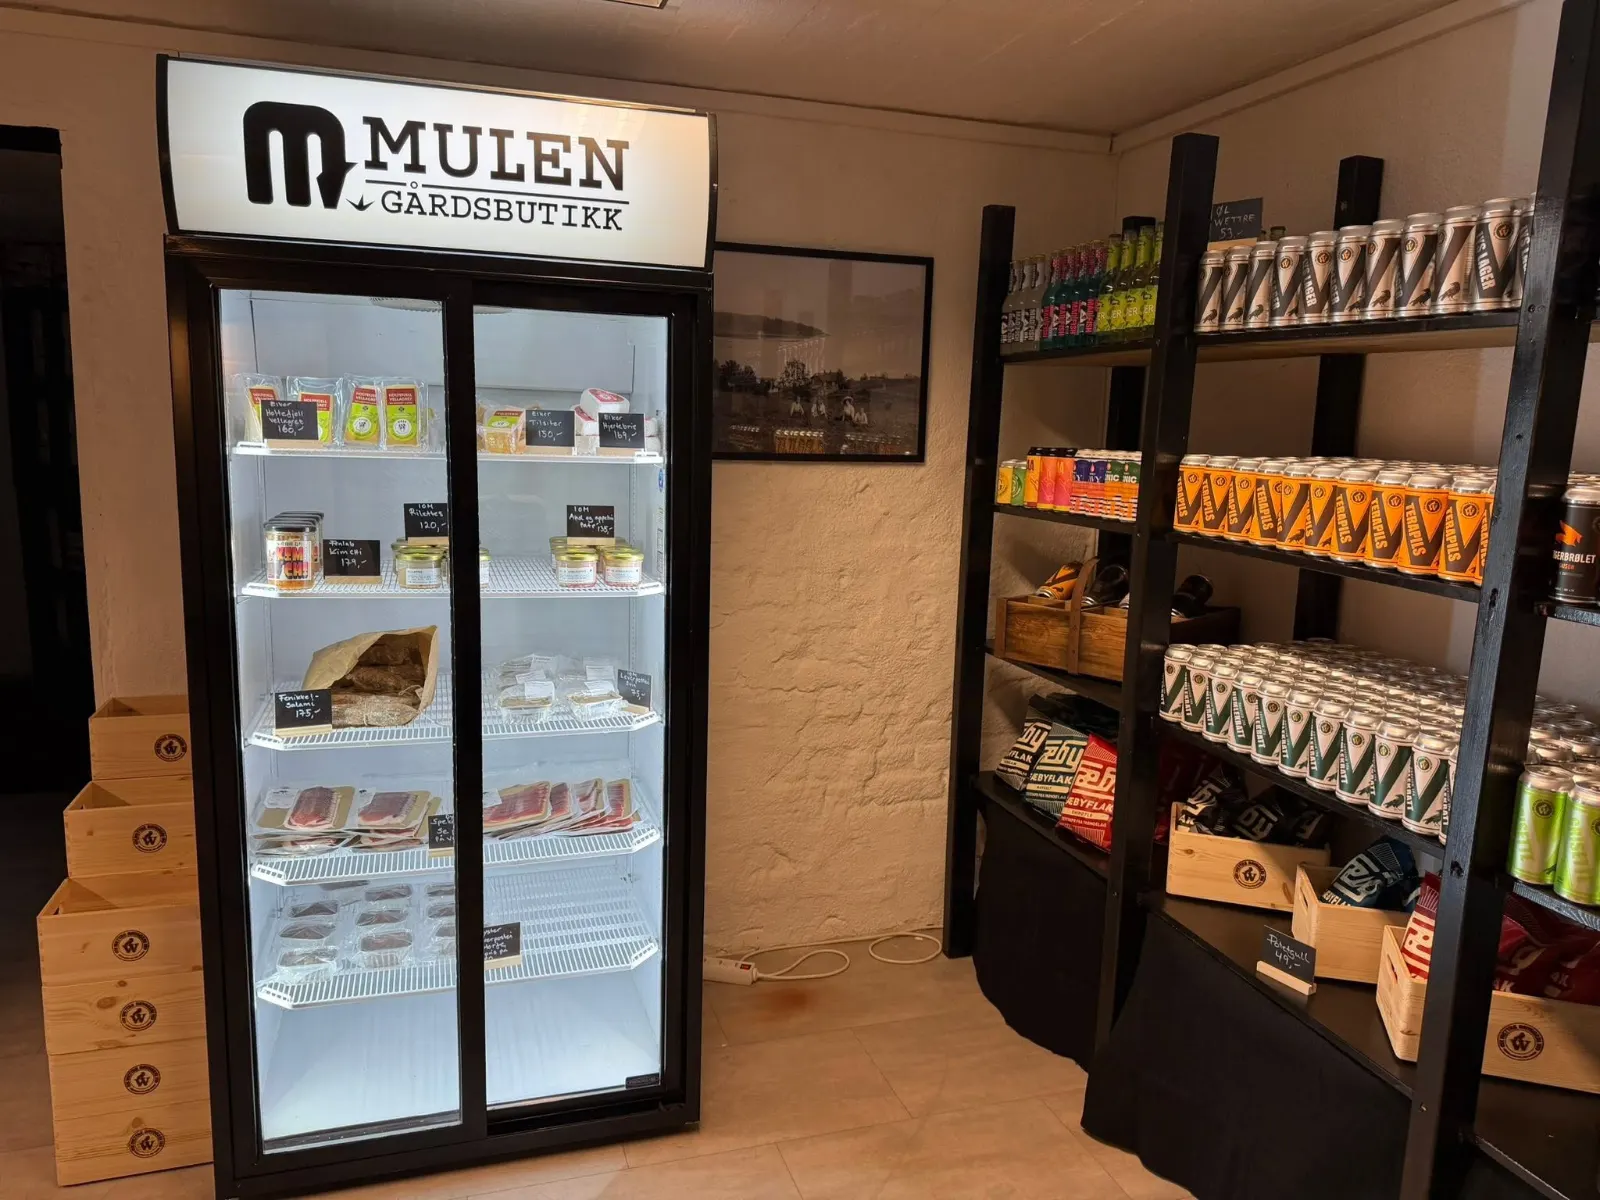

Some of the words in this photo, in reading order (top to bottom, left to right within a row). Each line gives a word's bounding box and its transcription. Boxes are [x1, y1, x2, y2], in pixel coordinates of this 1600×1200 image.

[363, 116, 630, 191] MULEN
[381, 181, 623, 231] GÅRDSBUTIKK
[1304, 274, 1318, 307] LAGER
[1478, 251, 1497, 291] LAGER
[1202, 478, 1215, 522] TERAPILS
[1256, 484, 1274, 531] TERAPILS
[1335, 493, 1352, 545] TERAPILS
[1371, 497, 1388, 550] TERAPILS
[1405, 502, 1427, 557] TERAPILS
[1446, 506, 1462, 562] TERAPILS
